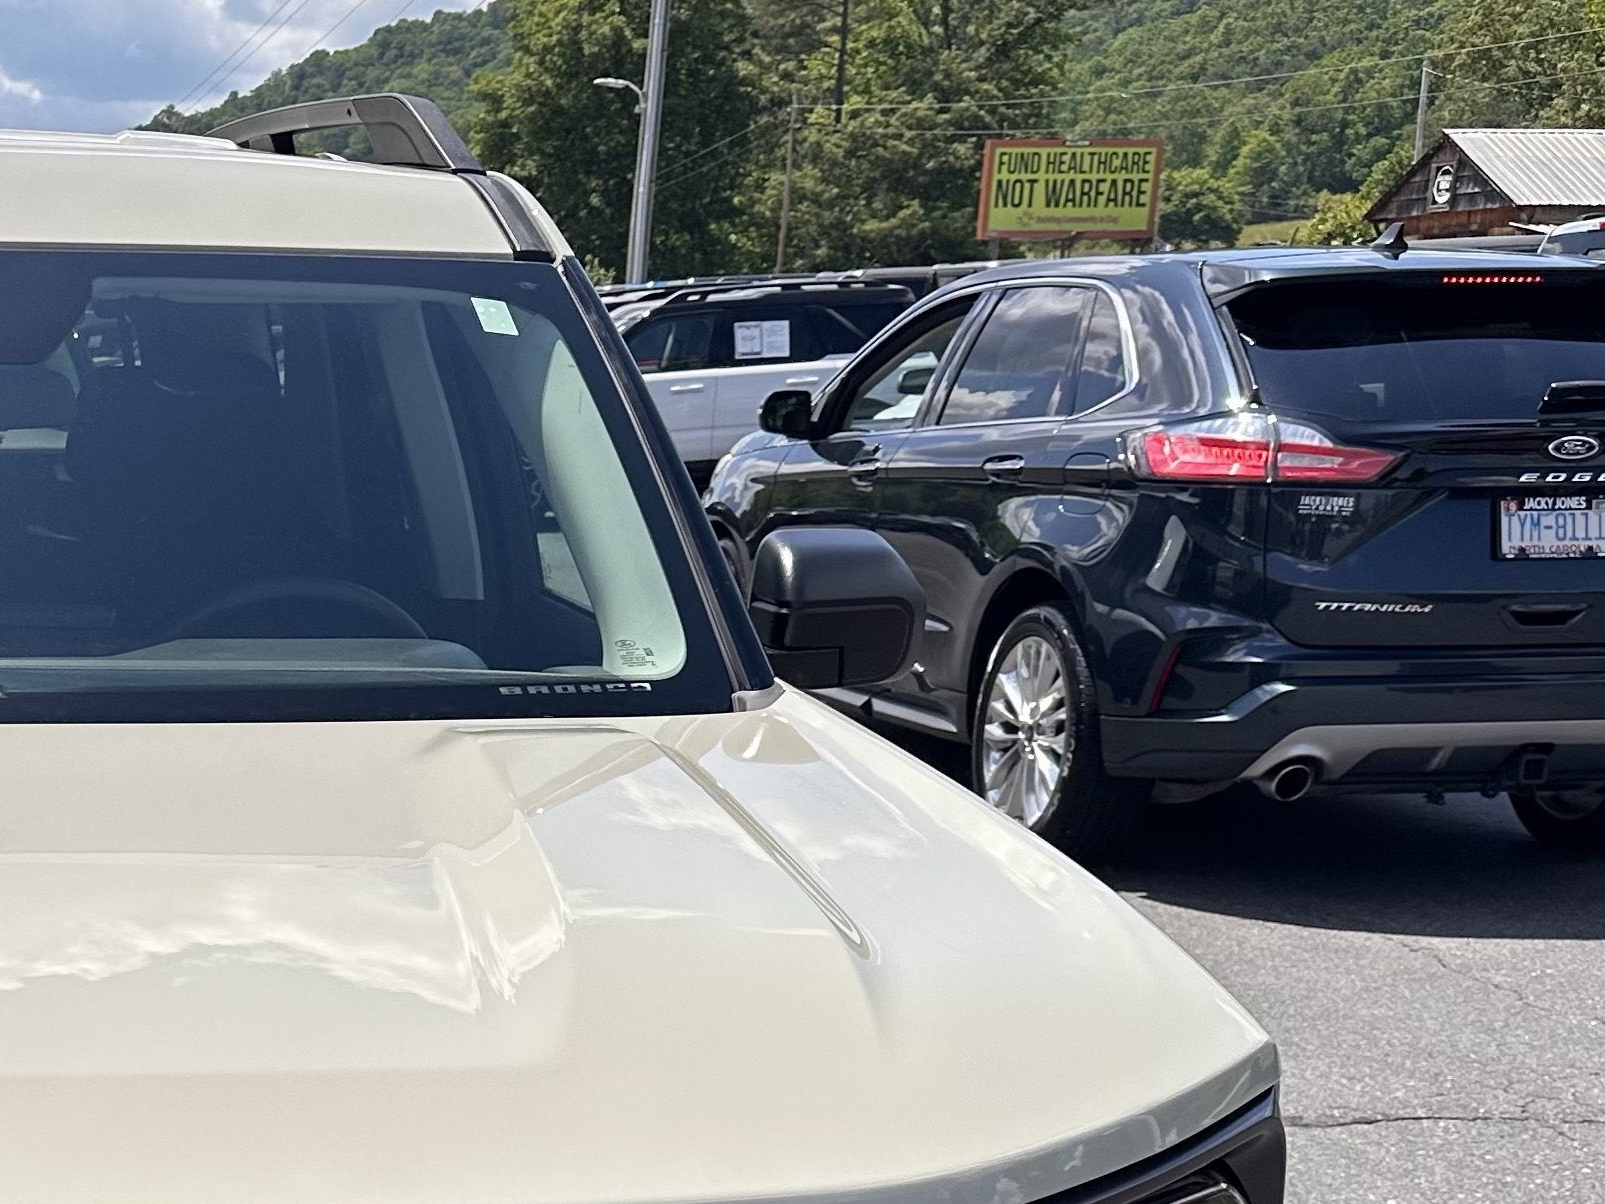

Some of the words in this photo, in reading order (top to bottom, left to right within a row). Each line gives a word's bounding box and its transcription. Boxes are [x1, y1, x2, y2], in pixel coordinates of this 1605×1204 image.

[997, 151, 1041, 174] FUND
[1045, 151, 1152, 174] HEALTHCARE
[994, 178, 1039, 208] NOT
[1045, 178, 1149, 208] WARFARE
[1523, 497, 1554, 510] JACKY
[1555, 496, 1587, 509] JONES
[1314, 601, 1434, 613] TITANIUM
